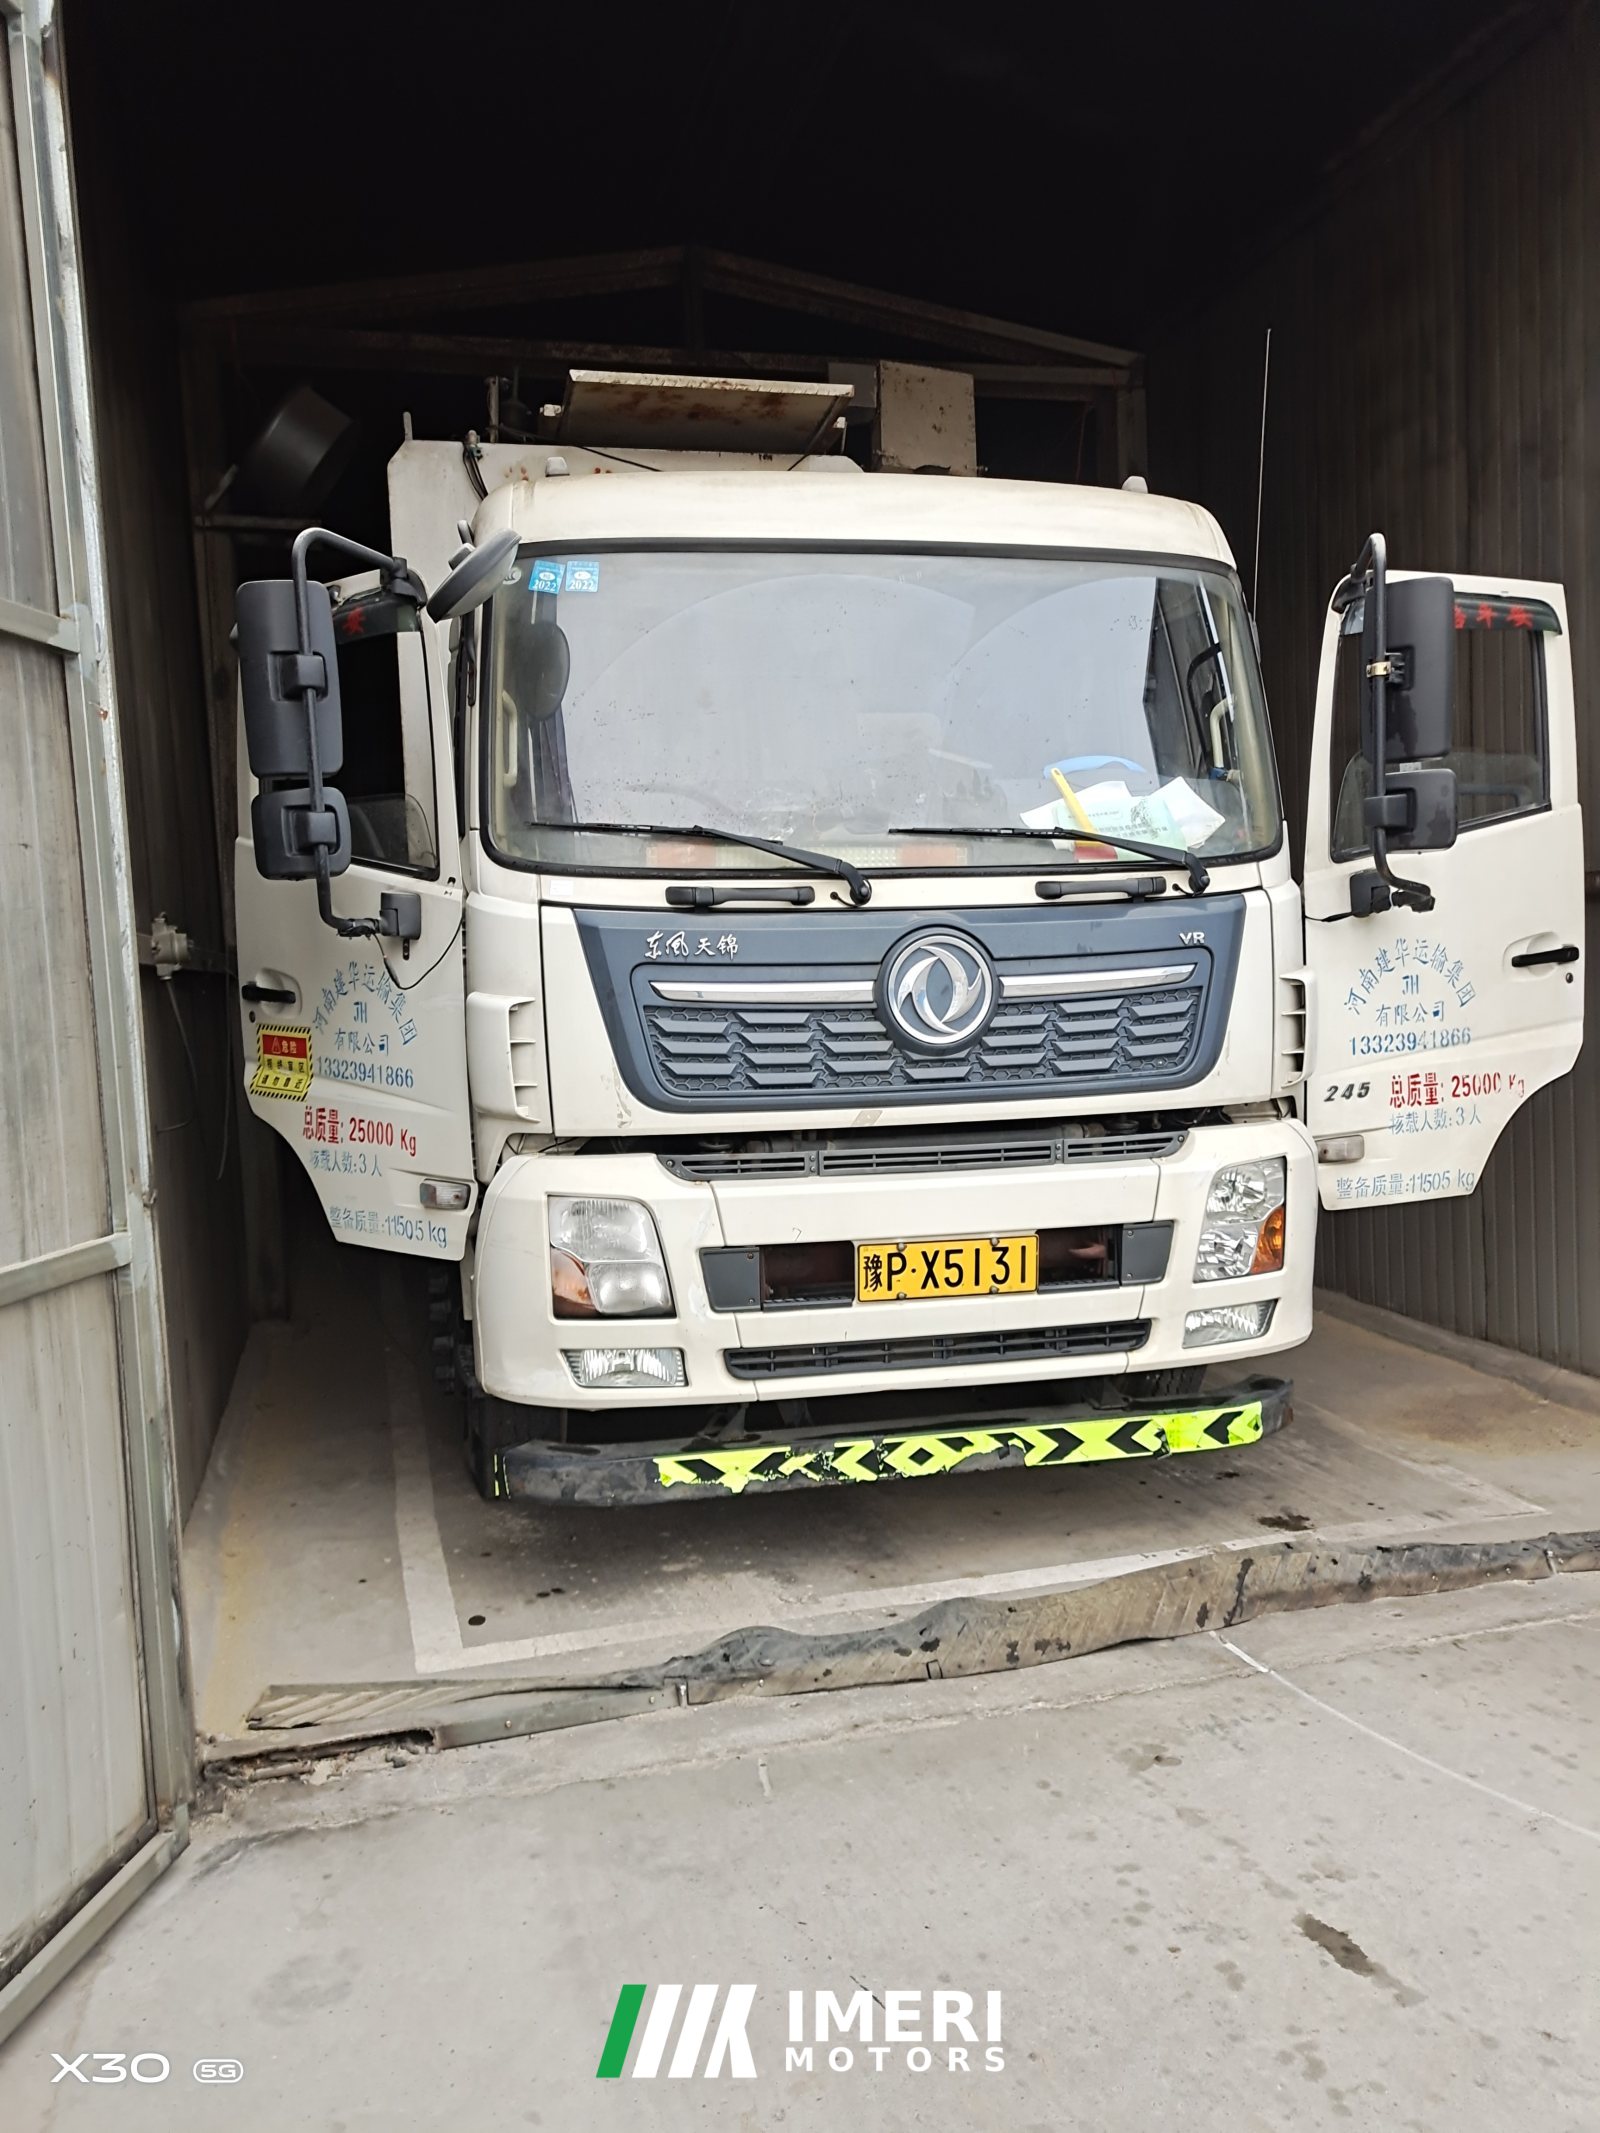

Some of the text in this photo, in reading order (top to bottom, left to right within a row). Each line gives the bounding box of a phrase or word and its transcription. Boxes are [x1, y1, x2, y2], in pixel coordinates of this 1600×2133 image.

[644, 930, 739, 960] 东风天锦
[1179, 931, 1205, 945] VR
[1344, 938, 1476, 1015] 河南建华运输集团
[1375, 1001, 1444, 1027] 有限公司
[335, 1028, 389, 1056] 有限公司
[1350, 1027, 1472, 1056] 13323941866
[317, 1056, 414, 1088] 13323941866
[1323, 1082, 1371, 1102] 245
[349, 1117, 394, 1147] 25000
[400, 1128, 417, 1157] Kg
[428, 1221, 447, 1248] kg
